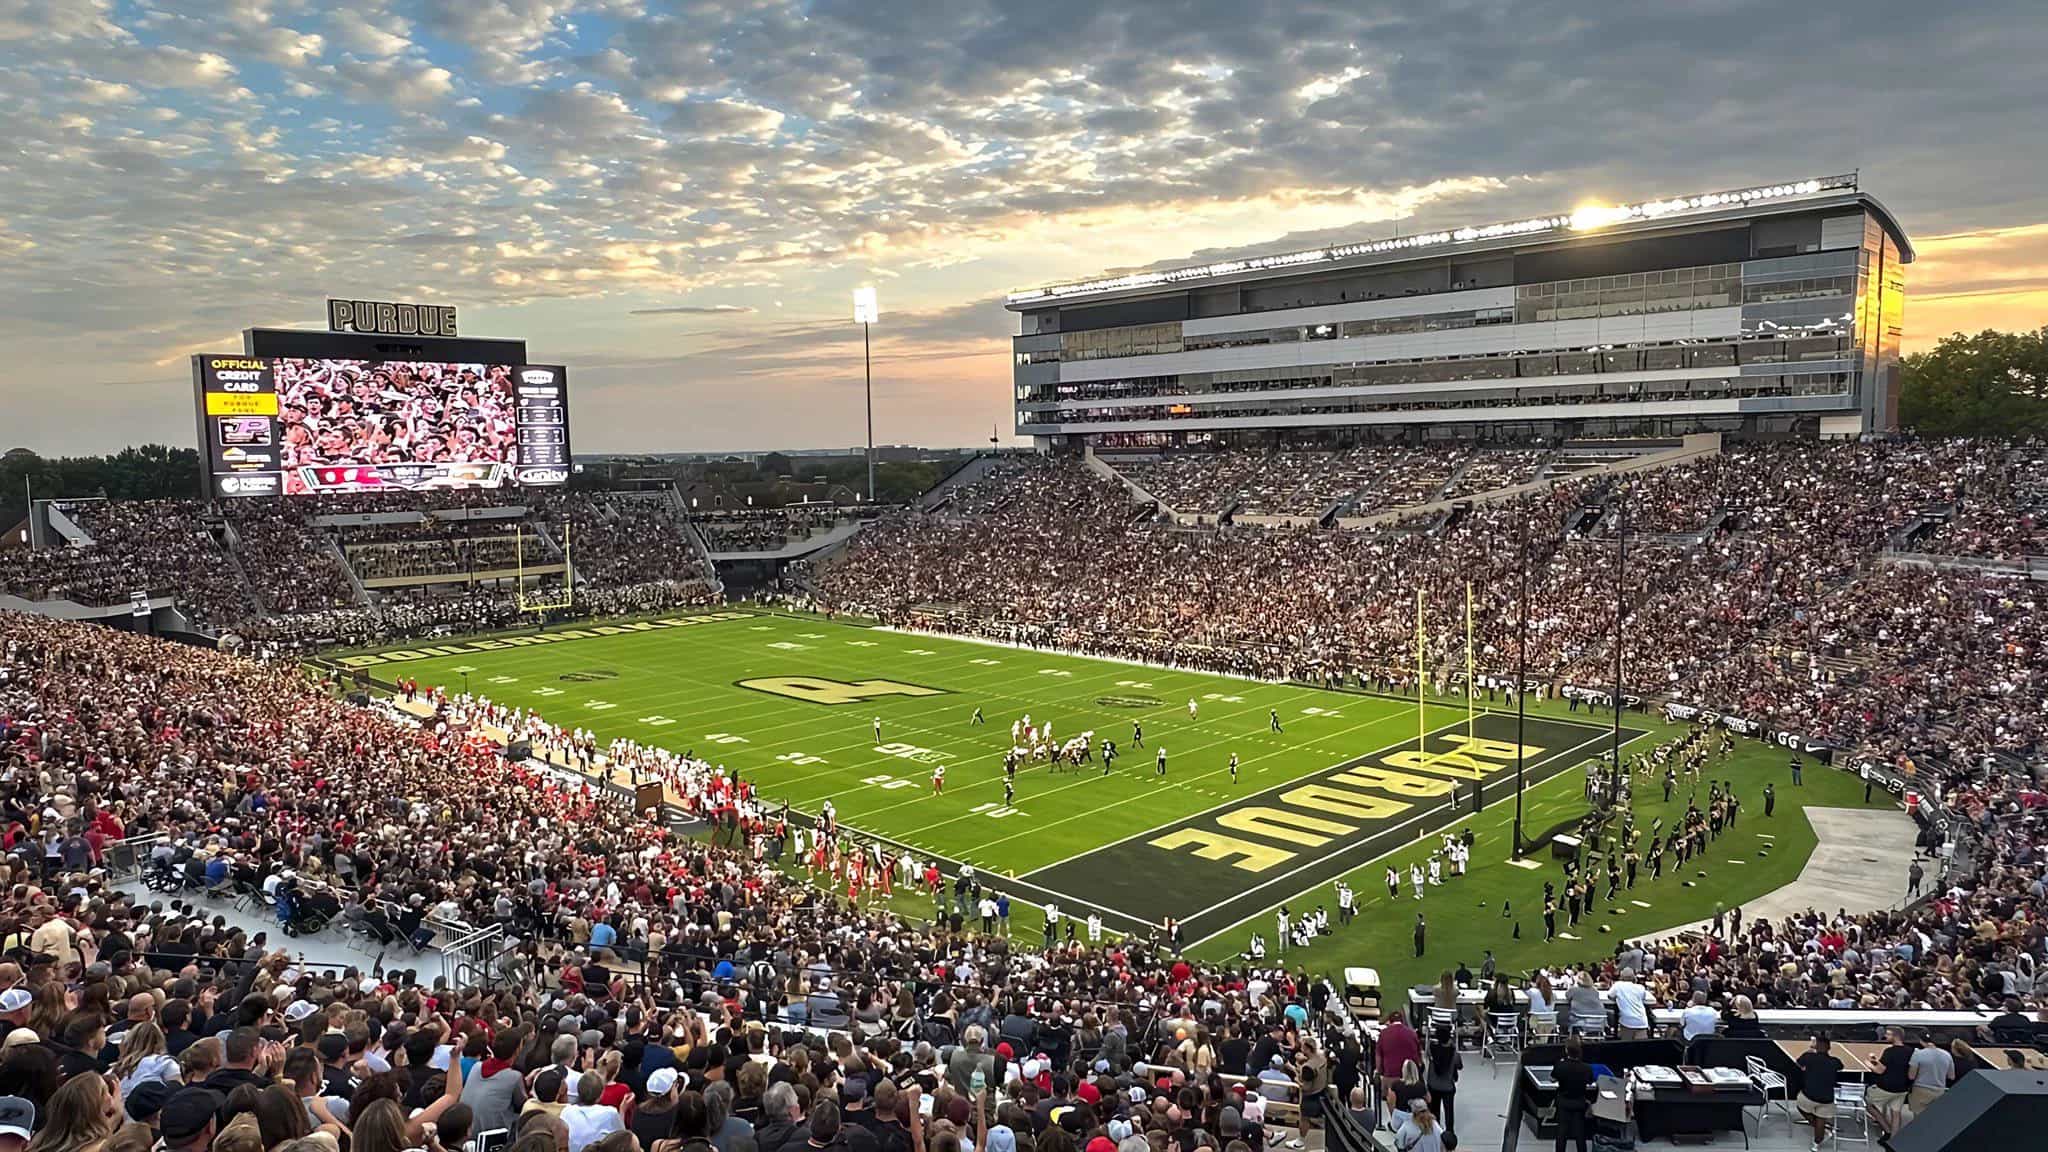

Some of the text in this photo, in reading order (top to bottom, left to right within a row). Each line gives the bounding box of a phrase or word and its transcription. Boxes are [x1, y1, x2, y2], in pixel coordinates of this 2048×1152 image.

[332, 300, 457, 336] PURDUE
[211, 359, 268, 370] OFFICIAL
[216, 371, 261, 380] CREDIT
[223, 382, 259, 392] CARD
[336, 611, 756, 667] BOILERMAKERS
[734, 675, 957, 705] P
[860, 774, 912, 789] 20
[1147, 734, 1547, 873] PURDUE
